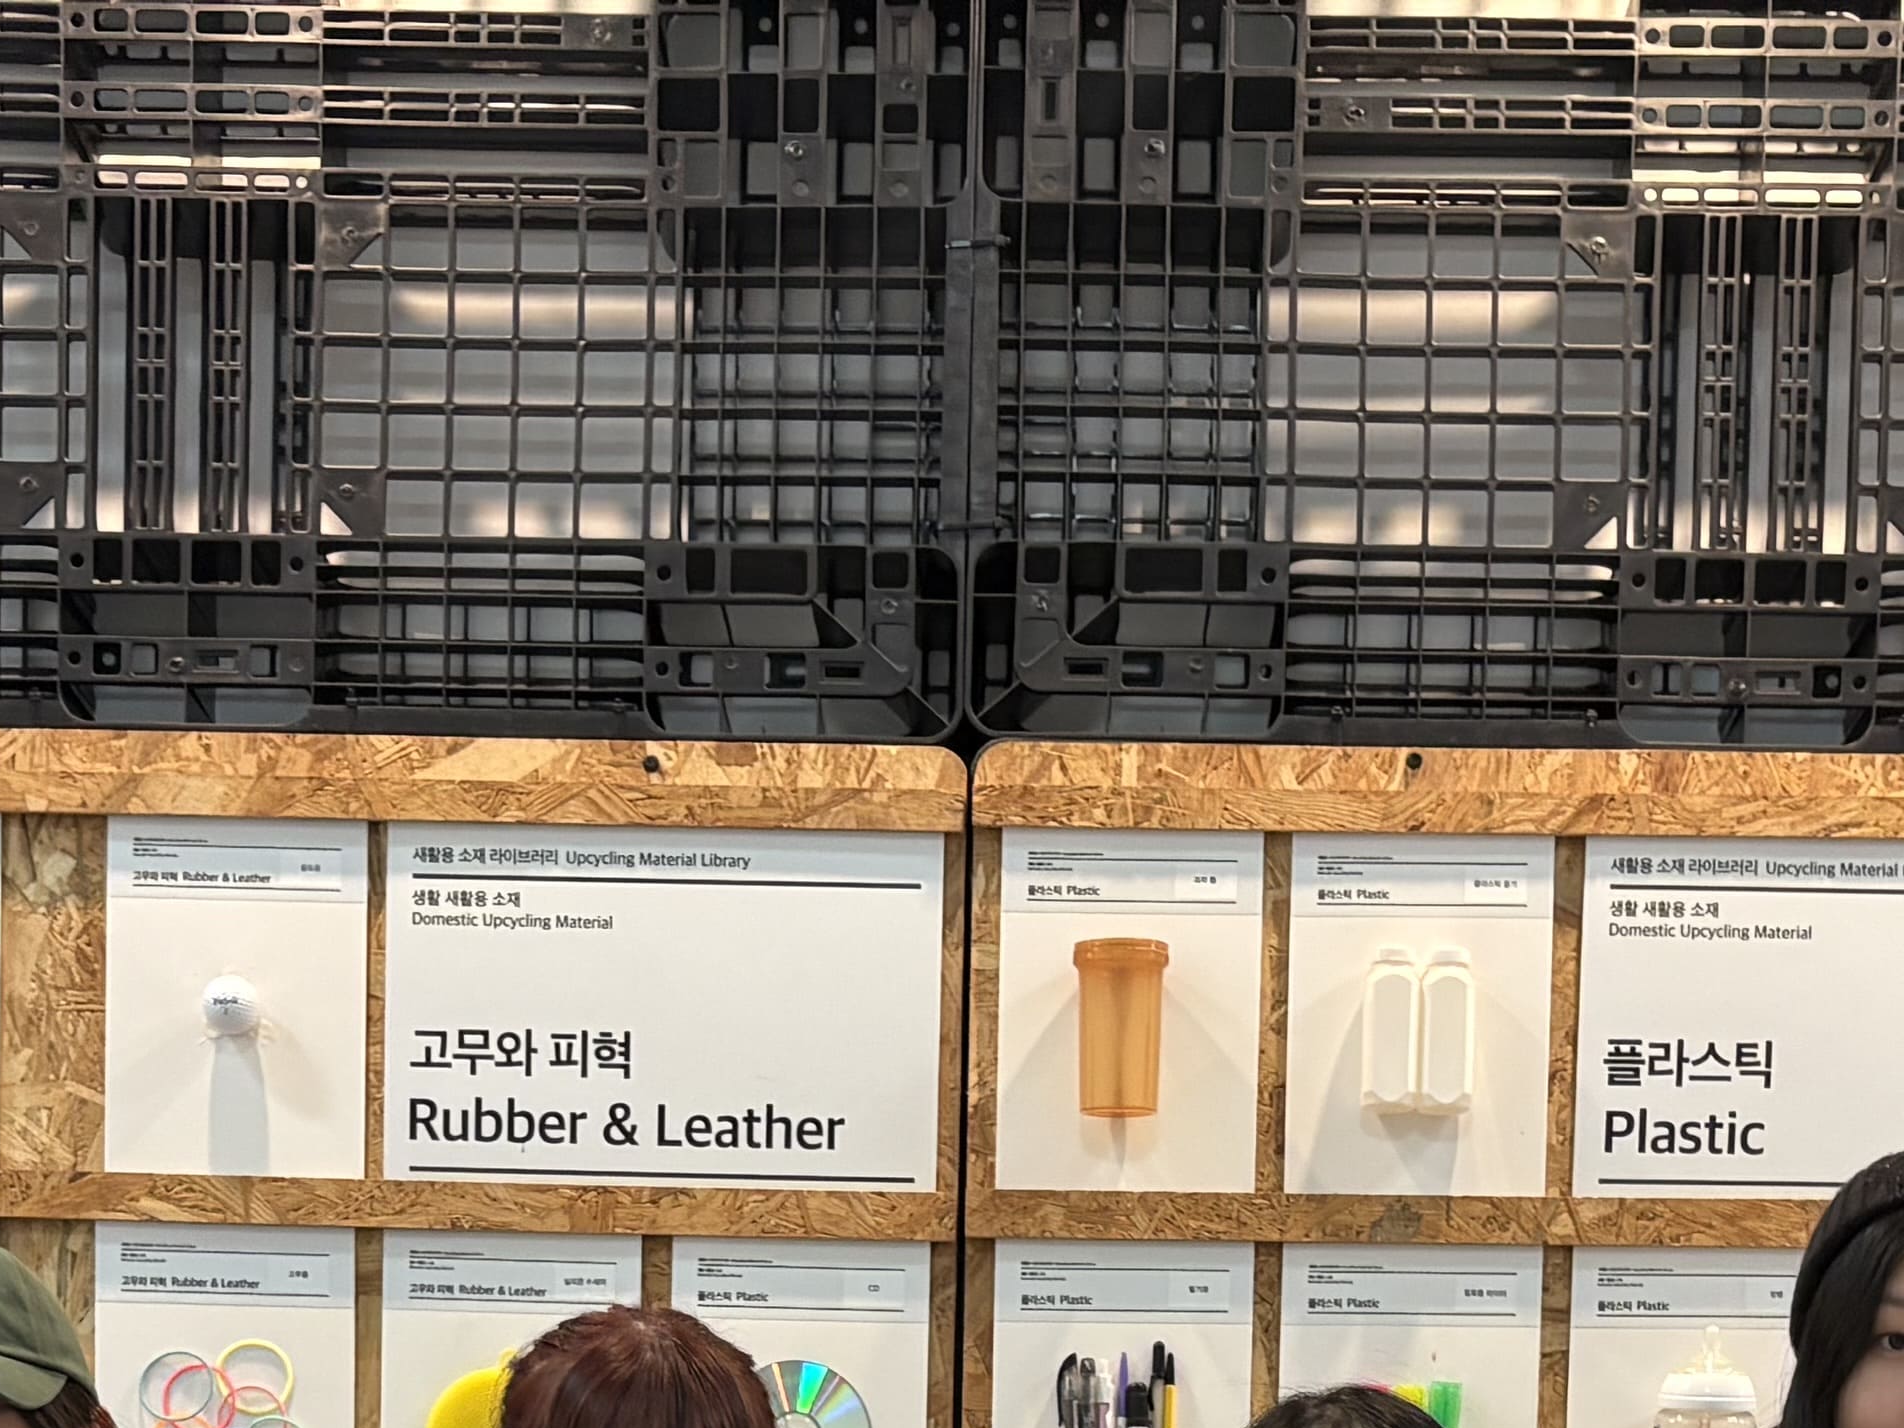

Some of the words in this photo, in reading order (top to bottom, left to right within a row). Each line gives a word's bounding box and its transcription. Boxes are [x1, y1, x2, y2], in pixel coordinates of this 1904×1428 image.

[413, 847, 454, 863] 새활용
[459, 848, 486, 864] 소재
[490, 848, 558, 865] 라이브러리
[566, 851, 635, 868] Upcycling
[640, 852, 696, 866] Material
[701, 853, 751, 870] Library
[1611, 857, 1653, 874] 새활용
[1656, 858, 1684, 874] 소재
[1689, 859, 1758, 876] 라이브러리
[1766, 861, 1835, 878] Upcycling
[1840, 863, 1898, 877] Material
[183, 871, 218, 881] Rubber
[233, 873, 271, 883] Leather
[412, 890, 440, 906] 생활
[445, 890, 488, 907] 새활용
[493, 892, 520, 907] 소재
[1067, 886, 1100, 896] Plastic
[1357, 889, 1389, 899] Plastic
[1610, 900, 1637, 917] 생활
[1643, 901, 1685, 918] 새활용
[1691, 902, 1719, 918] 소재
[412, 912, 478, 926] Domestic
[483, 913, 551, 930] Upcycling
[556, 915, 613, 929] Material
[1609, 923, 1675, 937] Domestic
[1680, 924, 1749, 941] Upcycling
[1754, 925, 1812, 939] Material
[410, 1029, 538, 1076] 고무와
[549, 1030, 630, 1079] 피혁
[1603, 1039, 1772, 1088] 플라스틱
[409, 1097, 587, 1144] Rubber
[603, 1103, 638, 1145] &
[658, 1104, 845, 1150] Leather
[1605, 1108, 1764, 1155] Plastic
[171, 1277, 208, 1287] Rubber
[221, 1279, 260, 1288] Leather
[459, 1285, 495, 1295] Rubber
[508, 1286, 547, 1296] Leather
[736, 1292, 768, 1302] Plastic
[1060, 1295, 1092, 1305] Plastic
[1347, 1298, 1379, 1308] Plastic
[1637, 1301, 1669, 1311] Plastic
